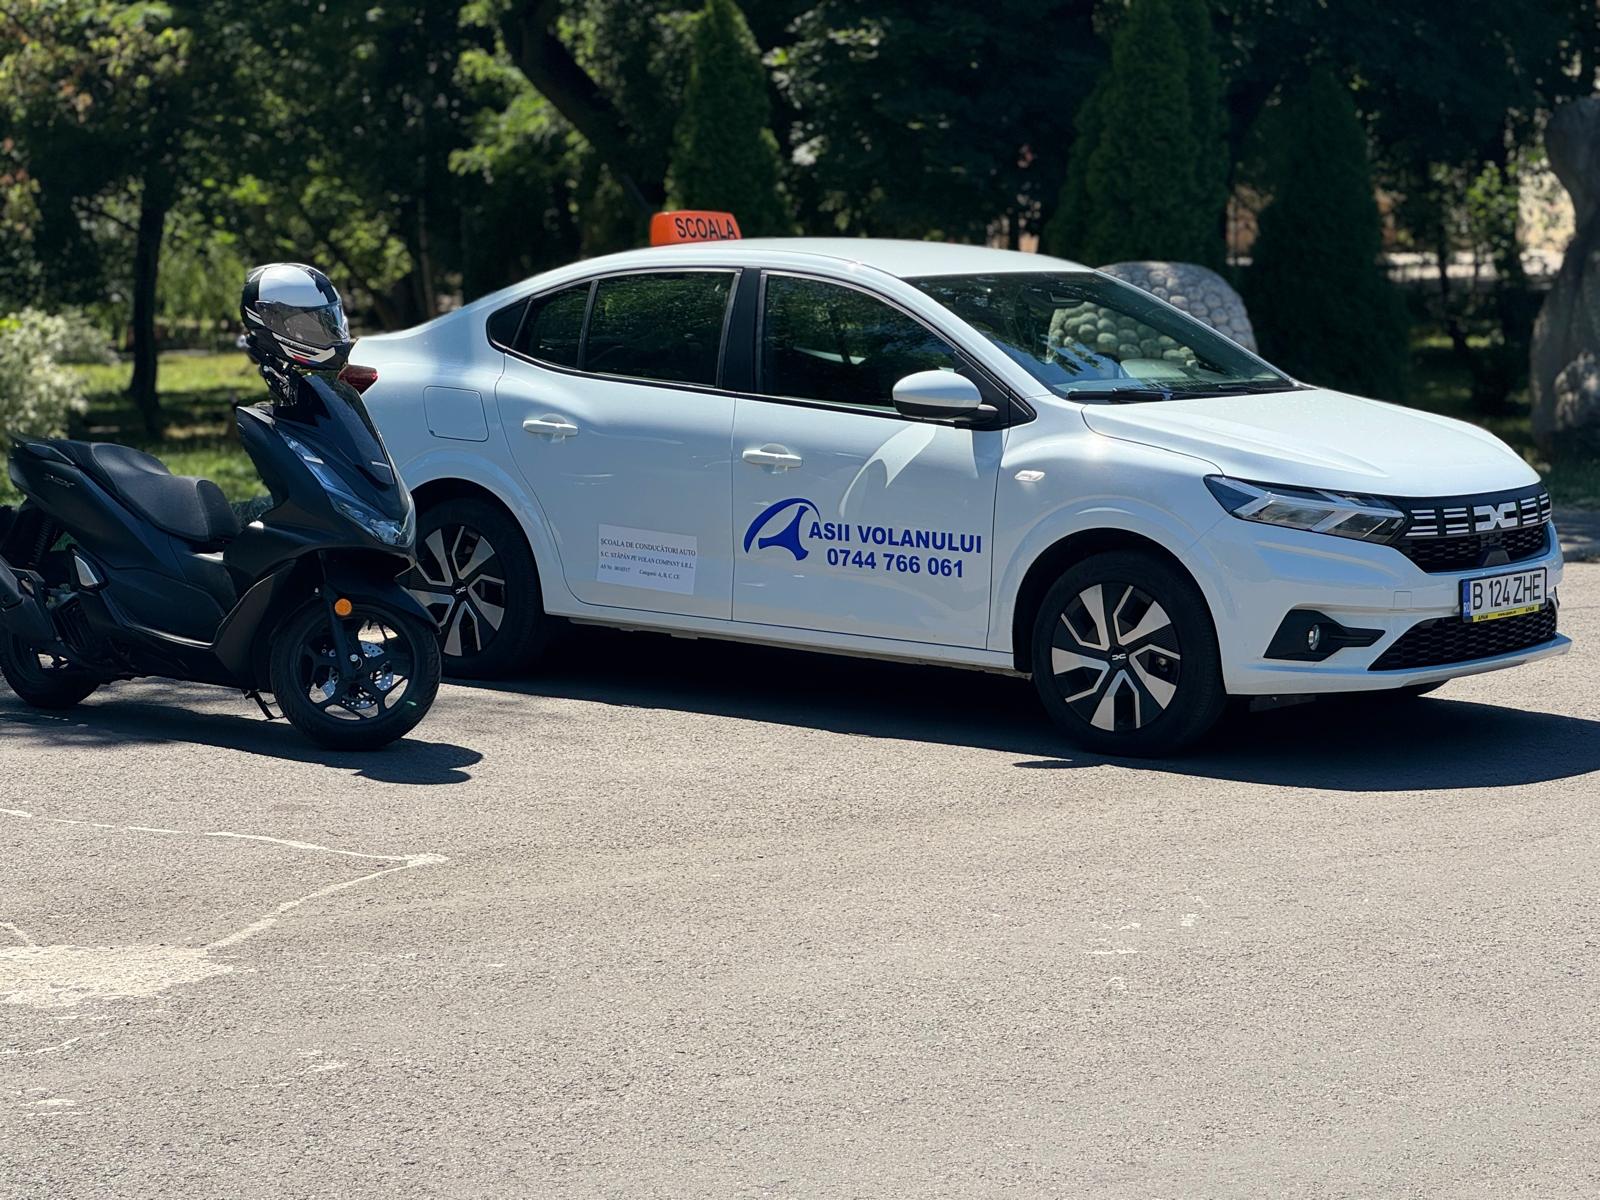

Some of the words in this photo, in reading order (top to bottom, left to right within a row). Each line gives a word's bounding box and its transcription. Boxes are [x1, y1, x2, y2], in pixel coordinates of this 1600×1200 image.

[675, 217, 737, 240] SCOALA
[626, 541, 634, 549] DE
[679, 547, 696, 557] AUTO
[808, 521, 851, 542] ASII
[857, 525, 982, 553] VOLANULUI
[827, 548, 877, 569] 0744
[883, 553, 921, 574] 766
[927, 557, 963, 578] 061
[1473, 582, 1483, 610] B
[1489, 578, 1510, 608] 124
[1513, 574, 1542, 604] ZHE
